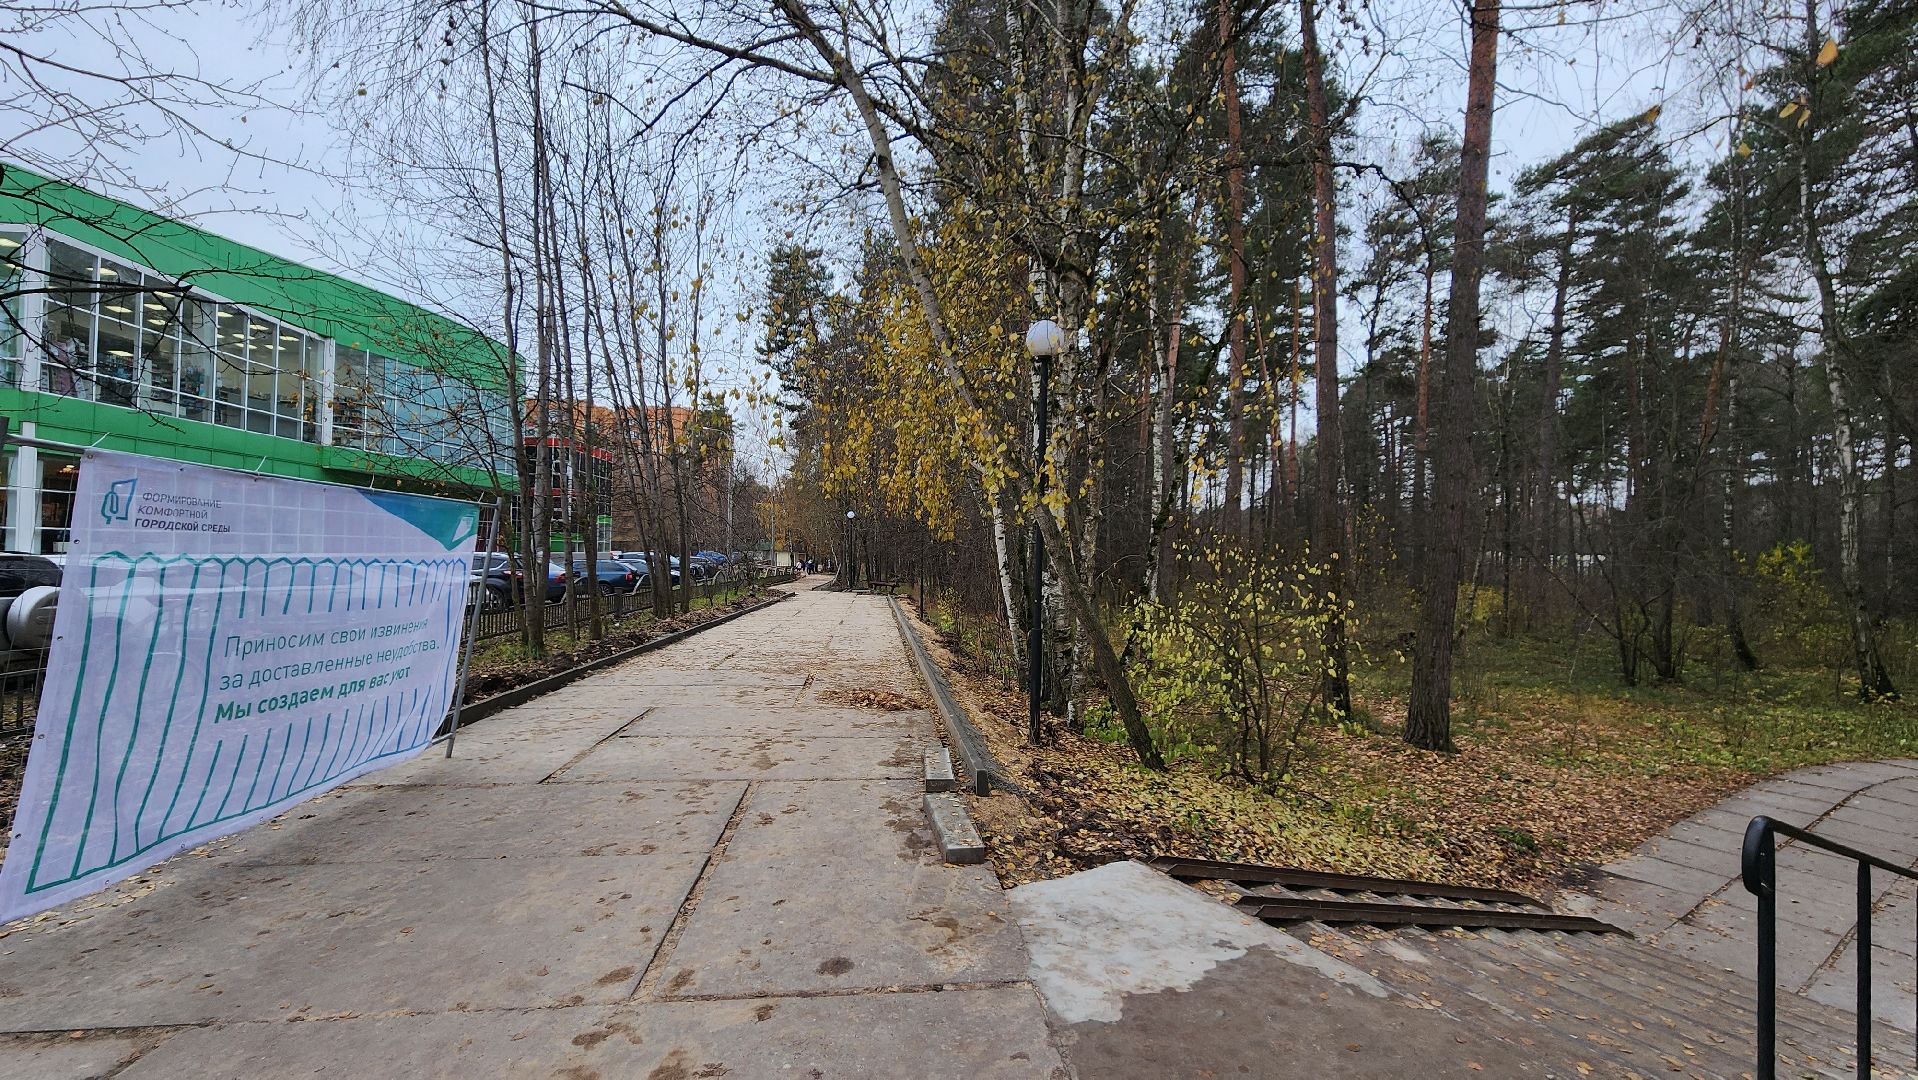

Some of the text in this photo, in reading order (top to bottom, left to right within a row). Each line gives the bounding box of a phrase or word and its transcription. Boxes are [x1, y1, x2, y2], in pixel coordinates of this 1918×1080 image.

[137, 505, 208, 519] КОМФОРТНОЙ
[142, 492, 222, 509] ФОРМИРОВАНИЕ
[134, 518, 231, 533] ГОРОДСКОЙ СРЕДЫ
[224, 632, 325, 661] Приносим
[330, 629, 366, 644] свои
[219, 673, 243, 691] за
[248, 653, 373, 690] доставленные
[214, 701, 252, 724] Мы
[257, 685, 334, 710] создаем
[337, 679, 366, 700] для
[369, 672, 390, 689] вас
